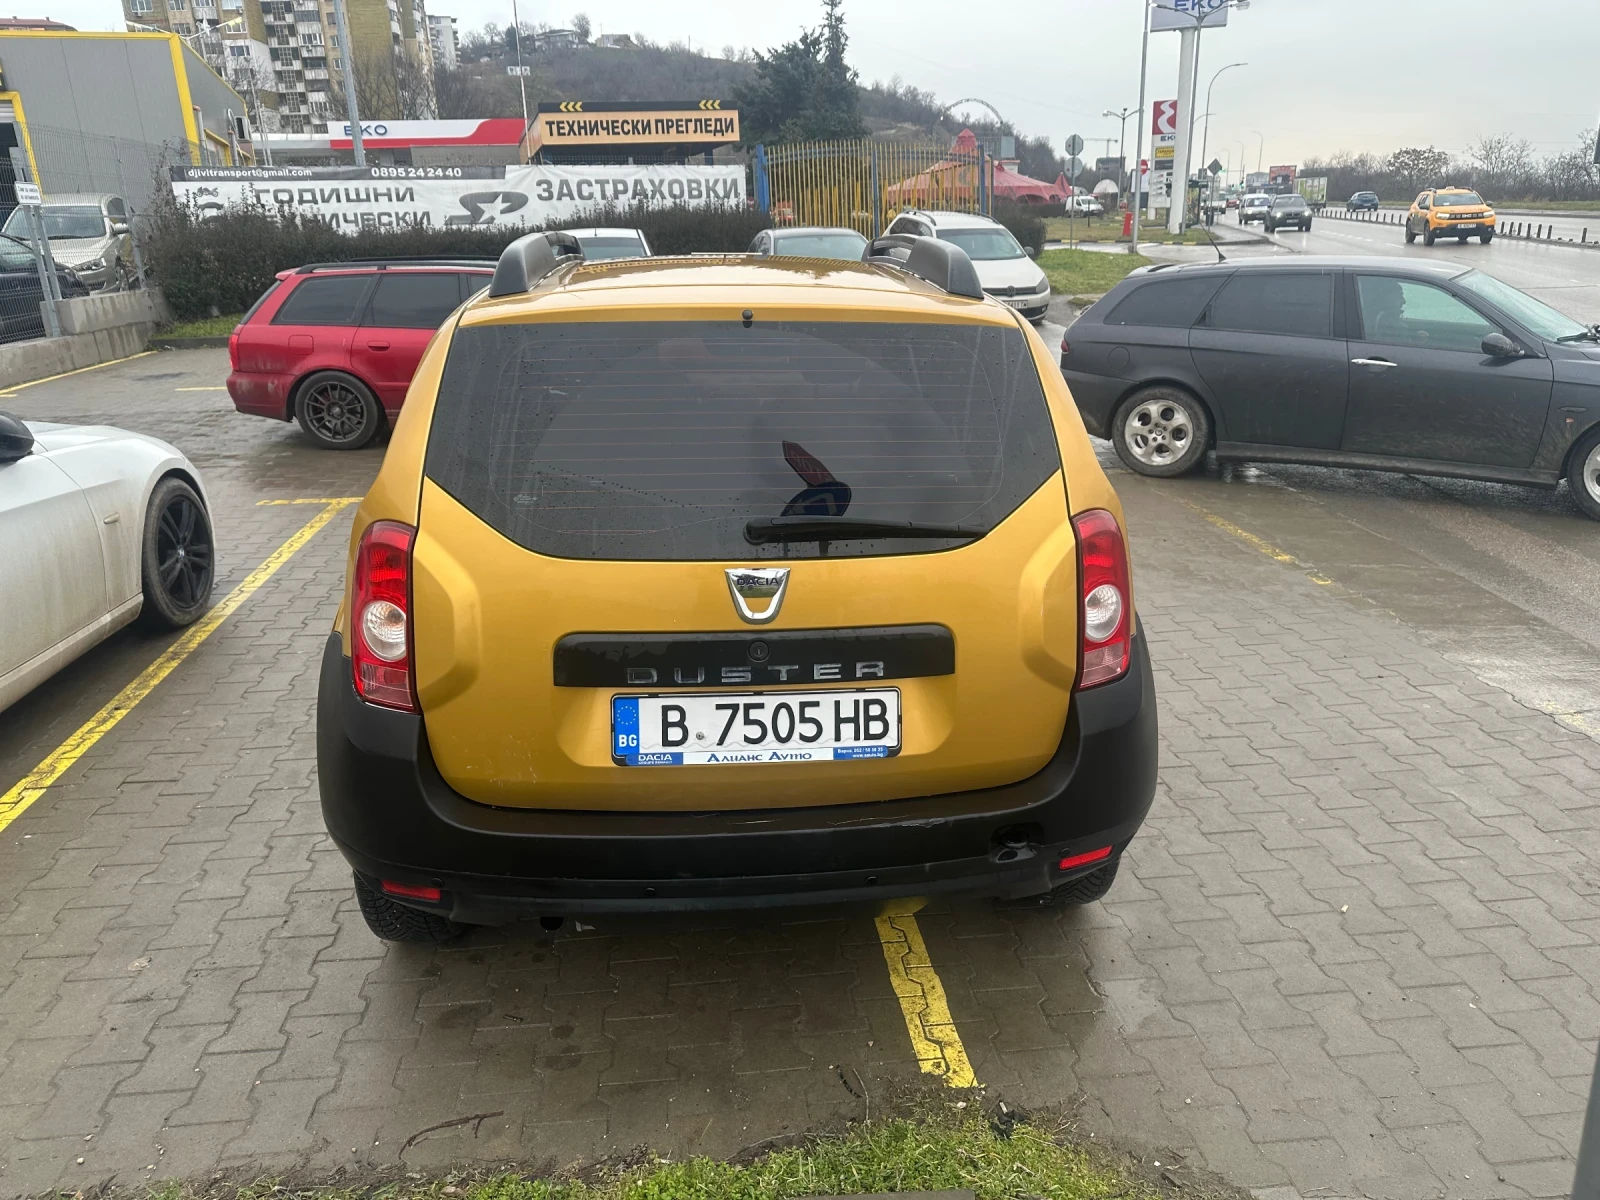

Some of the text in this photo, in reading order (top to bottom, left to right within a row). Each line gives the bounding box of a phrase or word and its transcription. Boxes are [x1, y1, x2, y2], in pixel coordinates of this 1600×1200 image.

[1174, 0, 1223, 11] EKO
[343, 124, 388, 136] EKO
[545, 117, 735, 137] ТЕХНИЧЕСКИ ПРЕГЛЕДИ
[188, 168, 313, 179] djivitransport@gmail.com
[371, 167, 462, 177] 0895 24 24 40
[254, 187, 415, 205] ГОДИШНИ
[535, 178, 739, 202] ЗАСТРАХОВКИ
[264, 211, 432, 230] ИЧЕСКИ
[736, 577, 779, 586] DACIA
[627, 661, 884, 684] DUSTER
[715, 700, 823, 746] 7505
[834, 698, 889, 742] HB
[618, 734, 637, 747] BG
[638, 753, 672, 761] DACIA
